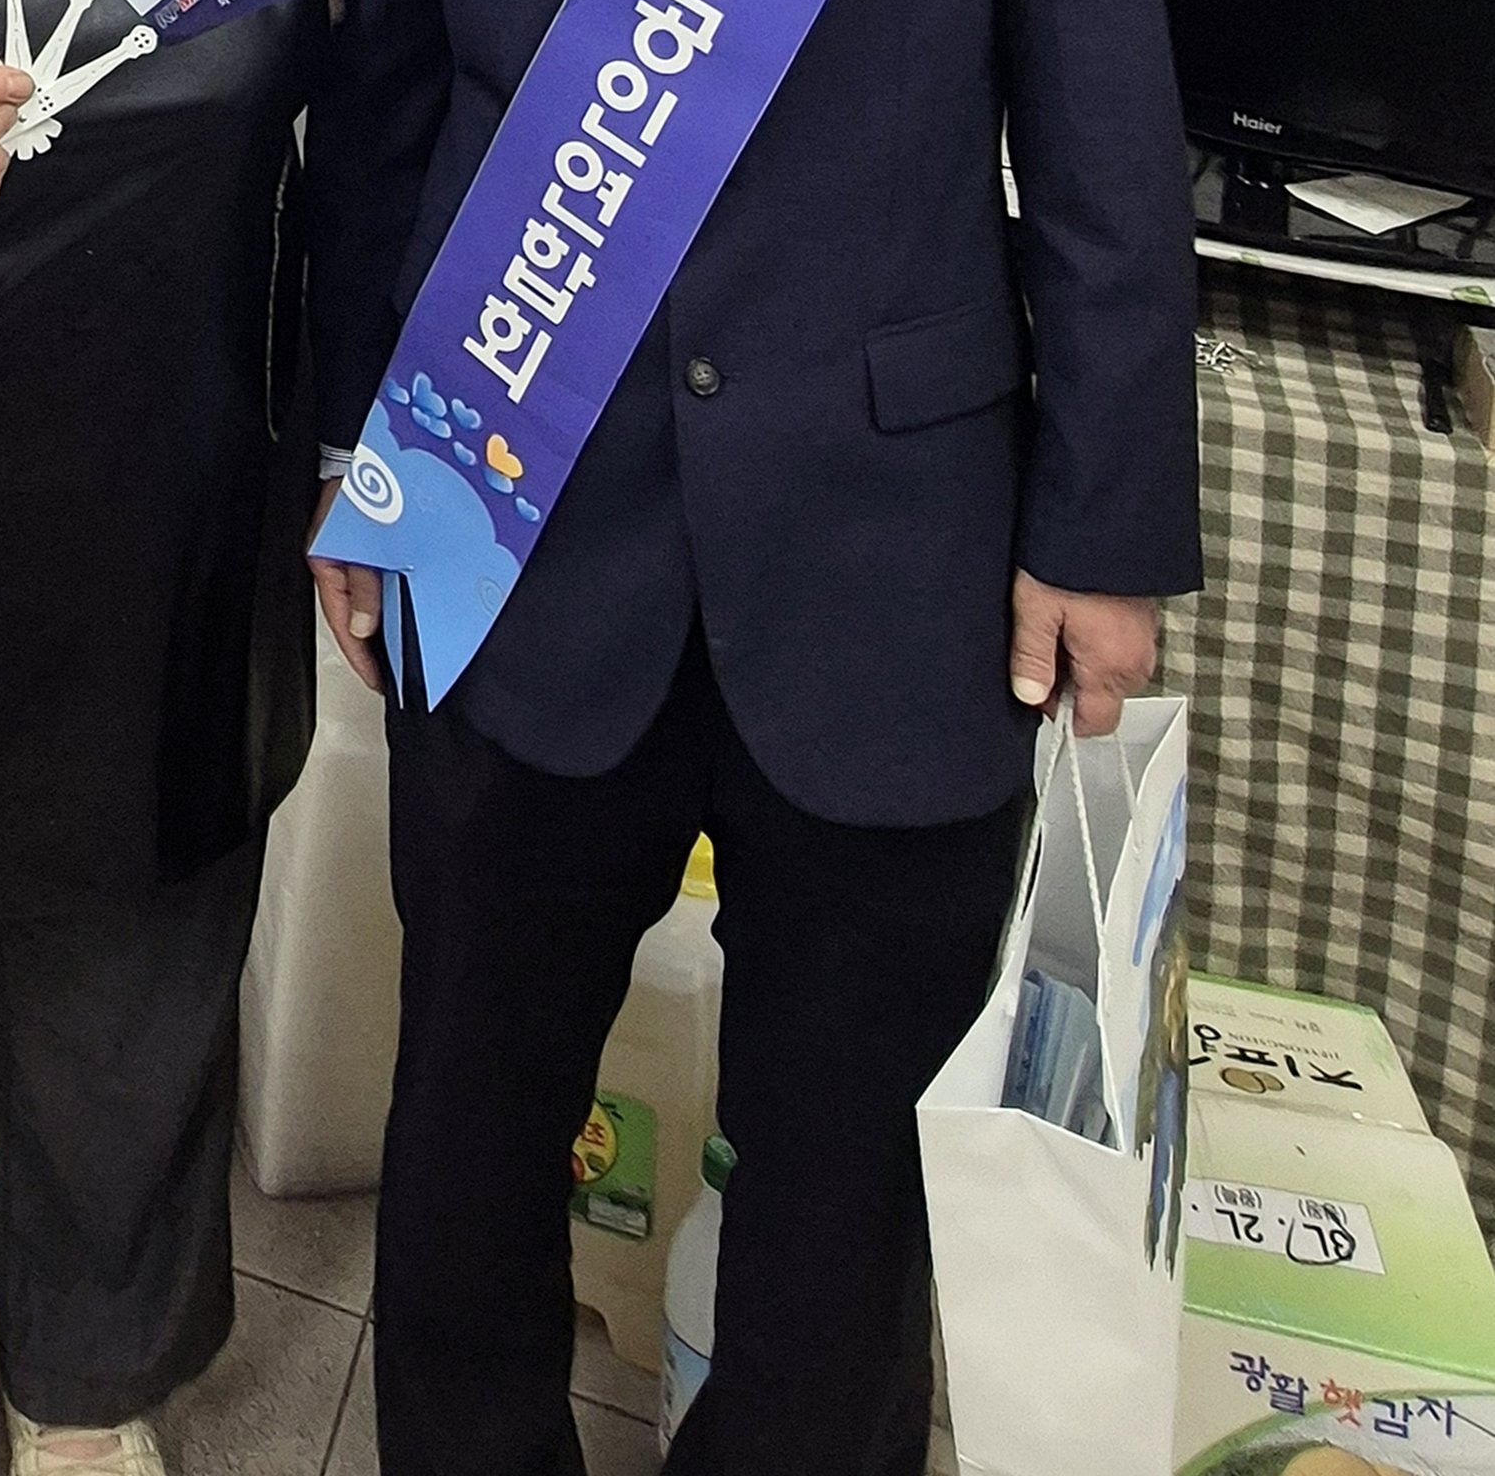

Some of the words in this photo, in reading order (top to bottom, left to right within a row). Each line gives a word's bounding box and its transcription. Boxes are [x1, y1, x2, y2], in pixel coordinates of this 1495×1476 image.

[1232, 110, 1282, 135] Haier
[1215, 1209, 1264, 1245] 2L
[1229, 1351, 1310, 1416] 광활
